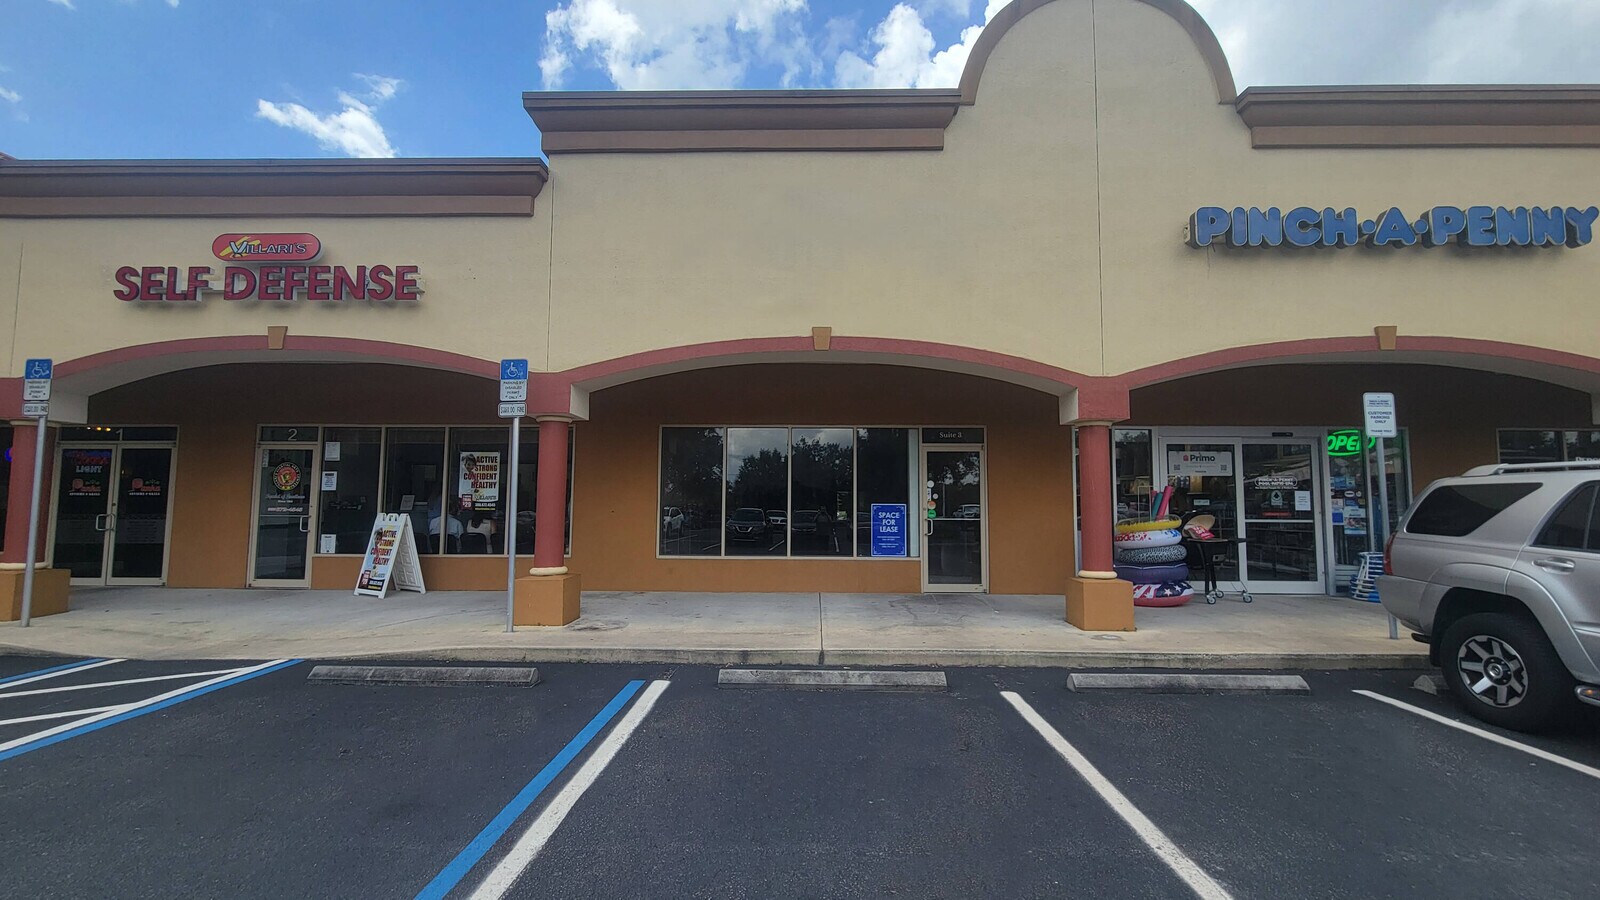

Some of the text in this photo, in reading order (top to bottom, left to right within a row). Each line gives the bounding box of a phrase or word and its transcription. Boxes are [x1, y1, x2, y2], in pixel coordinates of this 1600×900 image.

[229, 240, 307, 256] VILLARI'S
[113, 264, 419, 301] SELF DEFENSE
[287, 428, 298, 441] 2
[1327, 435, 1361, 451] OPE
[476, 455, 498, 463] ACTIVE
[475, 464, 497, 472] STRONG
[463, 472, 497, 480] CONFIDENT
[471, 481, 497, 489] HEALTHY
[878, 511, 900, 519] SPACE
